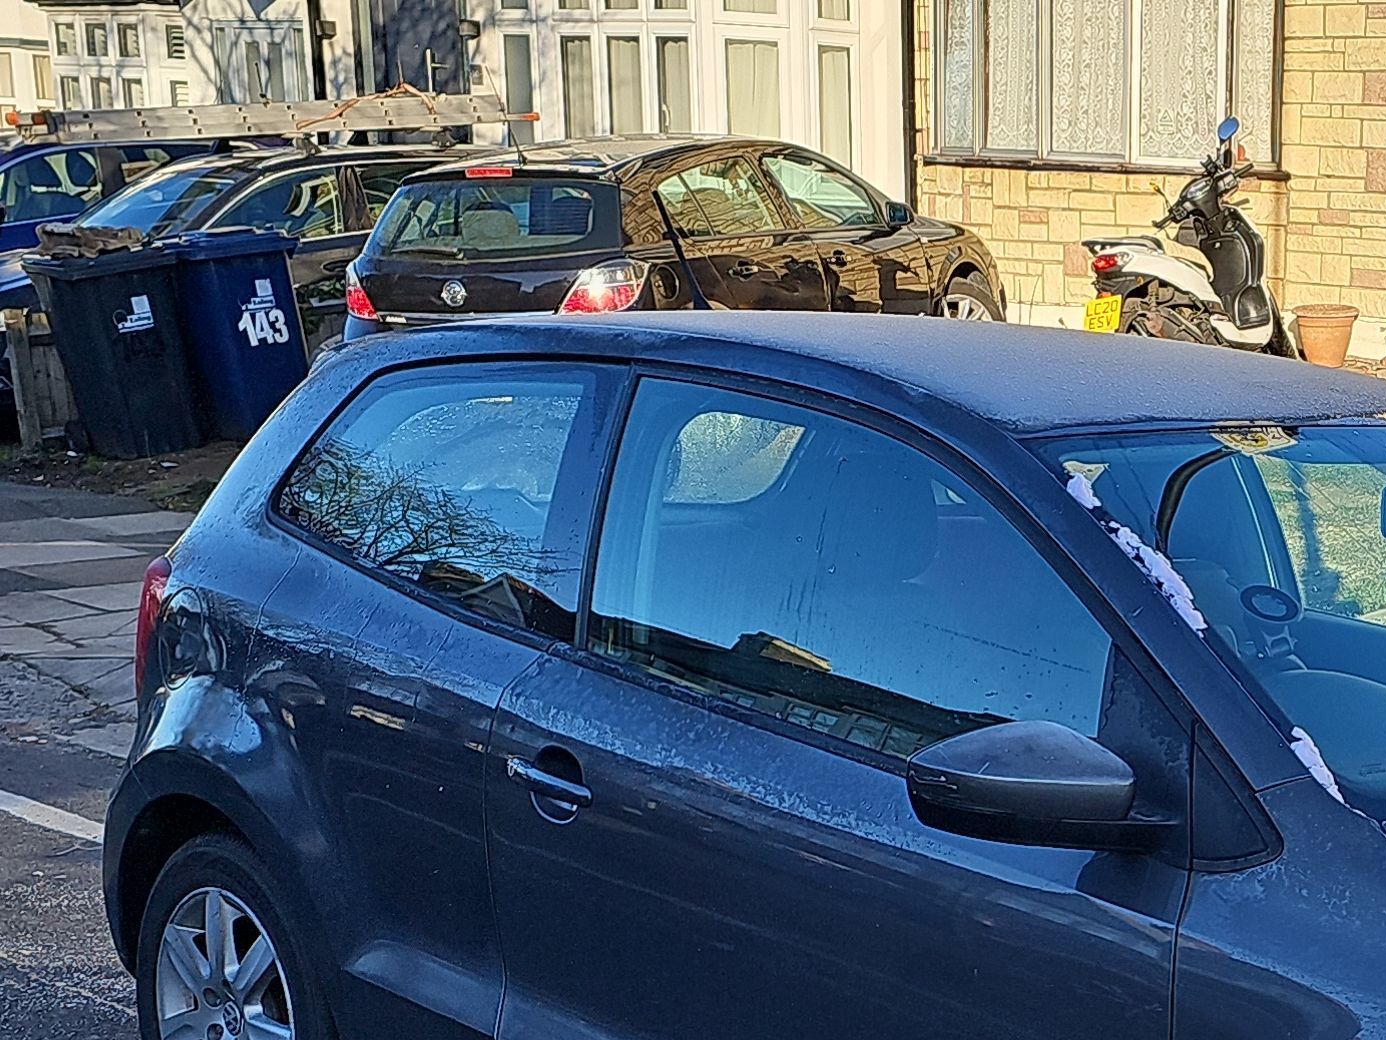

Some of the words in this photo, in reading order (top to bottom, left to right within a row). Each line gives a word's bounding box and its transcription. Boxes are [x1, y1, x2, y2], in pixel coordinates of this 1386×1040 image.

[1086, 299, 1118, 317] LC20
[238, 308, 289, 347] 143
[1089, 314, 1112, 330] ESV
